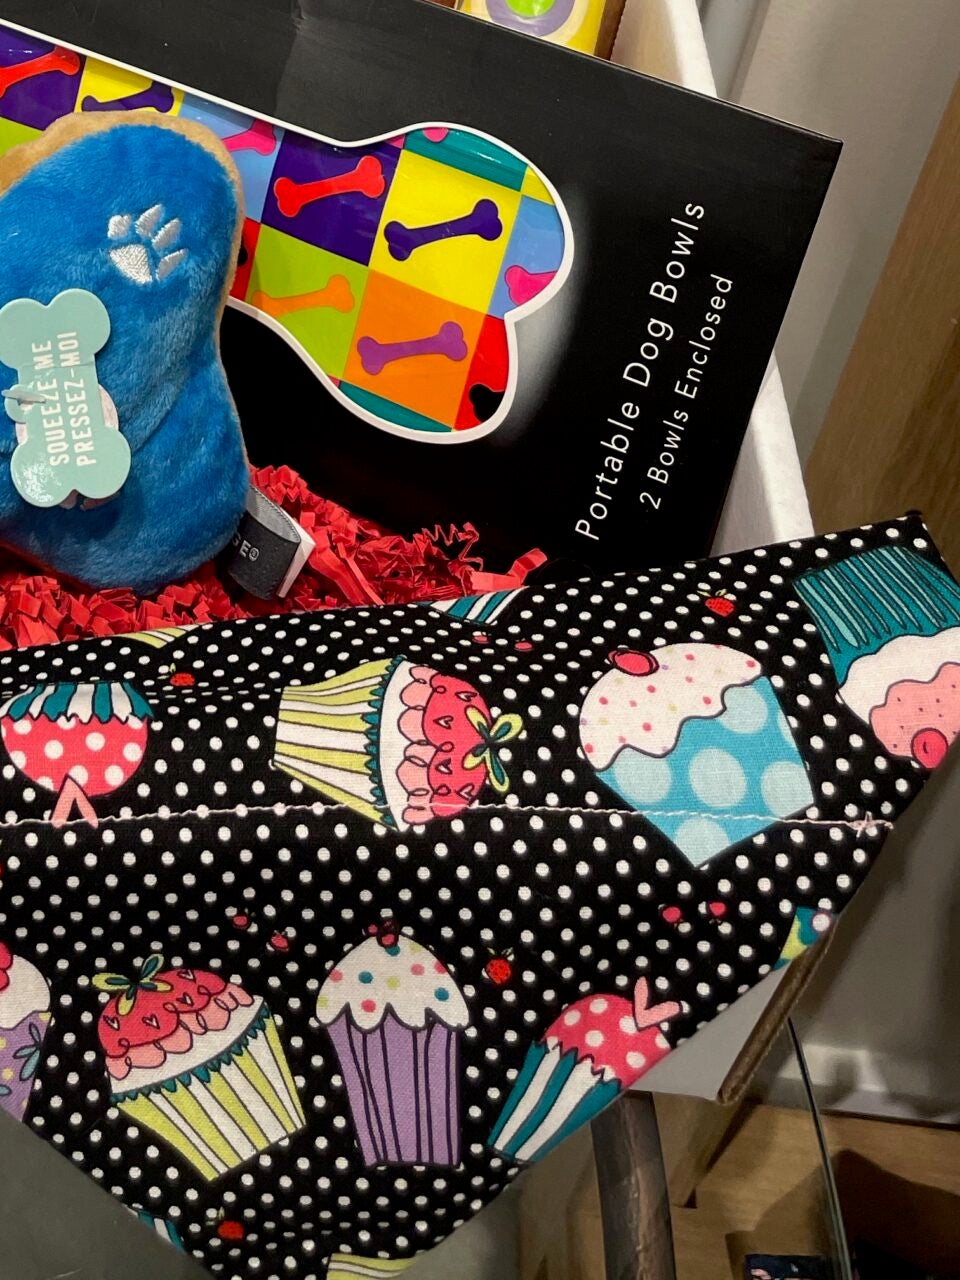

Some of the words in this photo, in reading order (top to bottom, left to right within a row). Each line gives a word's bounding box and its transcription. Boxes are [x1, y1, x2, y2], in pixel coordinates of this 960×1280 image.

[31, 340, 55, 370] ME
[574, 400, 640, 541] Portable
[622, 317, 674, 387] Dog
[649, 202, 705, 303] Bowls
[674, 273, 734, 399] Enclosed
[56, 331, 97, 466] PRESSEZ-MOI
[646, 408, 689, 484] Bowls
[640, 491, 661, 510] 2
